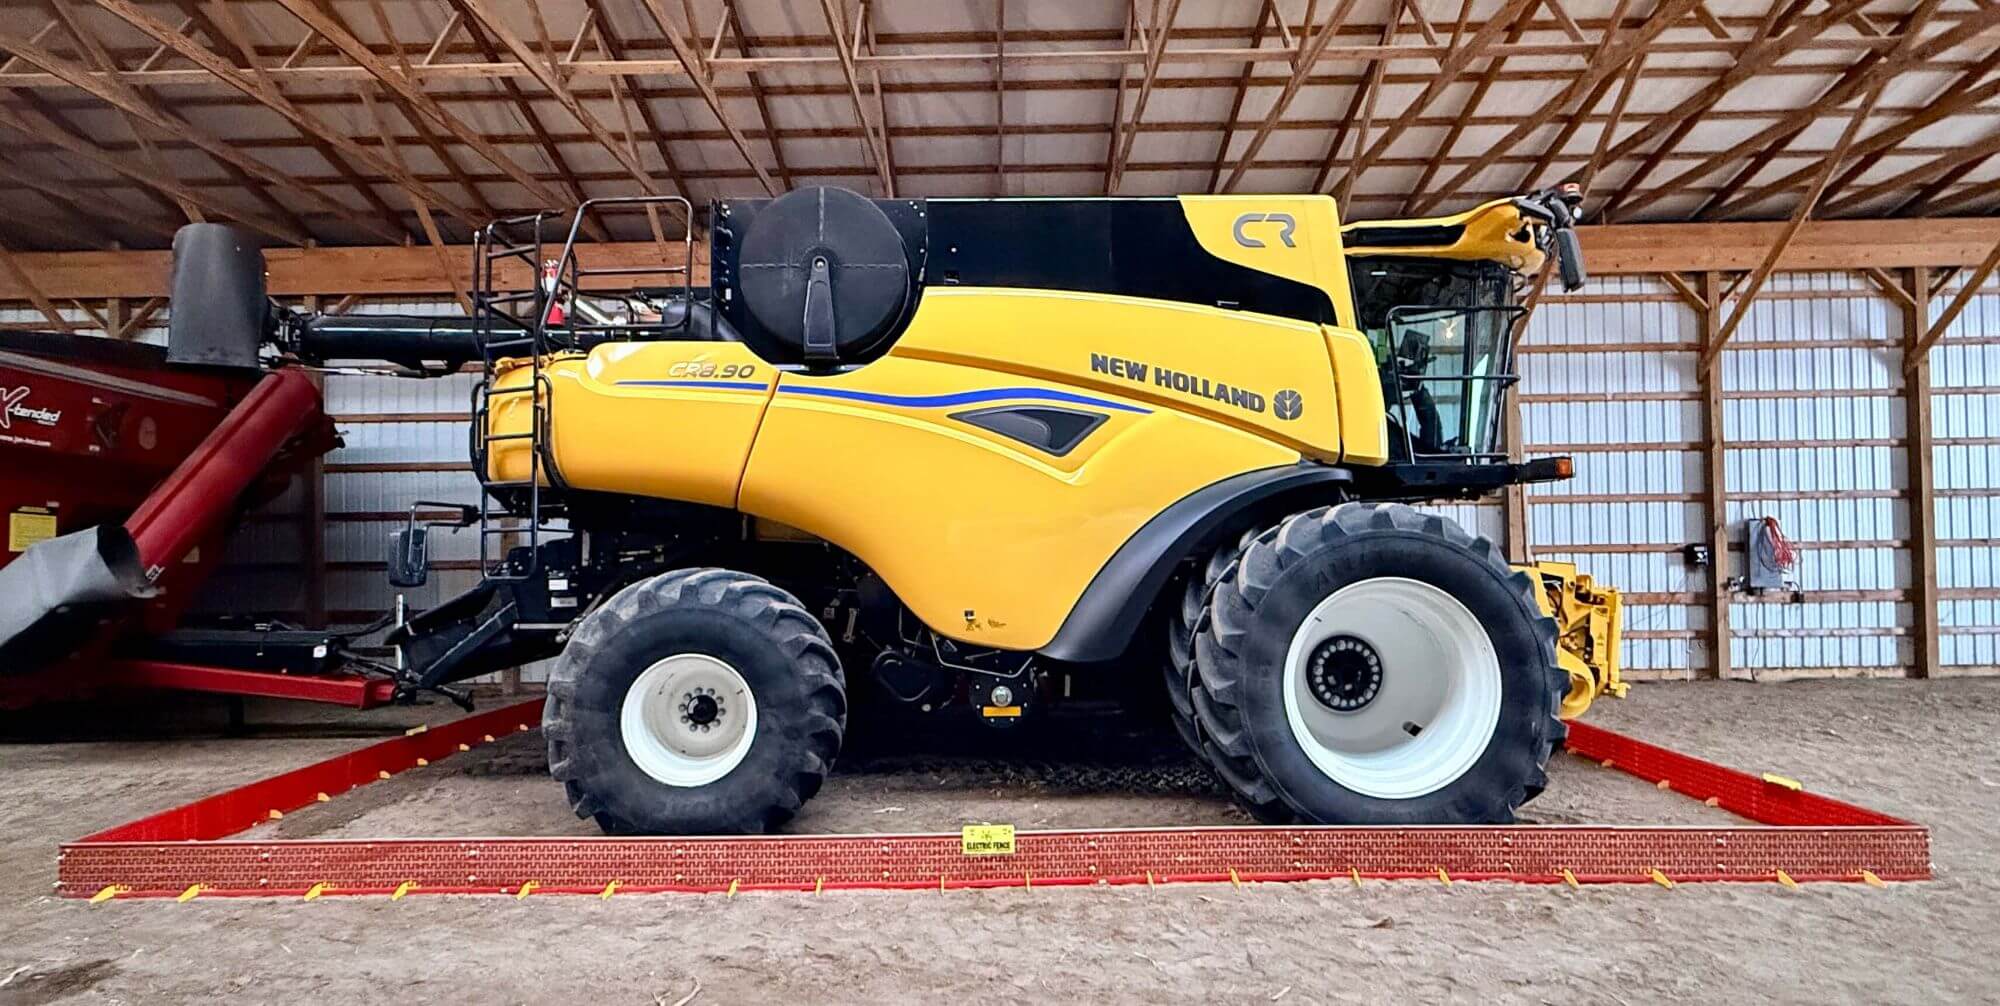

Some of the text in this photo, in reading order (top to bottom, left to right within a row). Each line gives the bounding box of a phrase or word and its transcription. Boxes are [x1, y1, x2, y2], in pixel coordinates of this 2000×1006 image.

[1233, 213, 1296, 248] CR
[668, 361, 755, 379] CR8.90
[1091, 353, 1265, 413] NEW HOLLAND
[966, 841, 1010, 850] ELECTRIC FENCE
